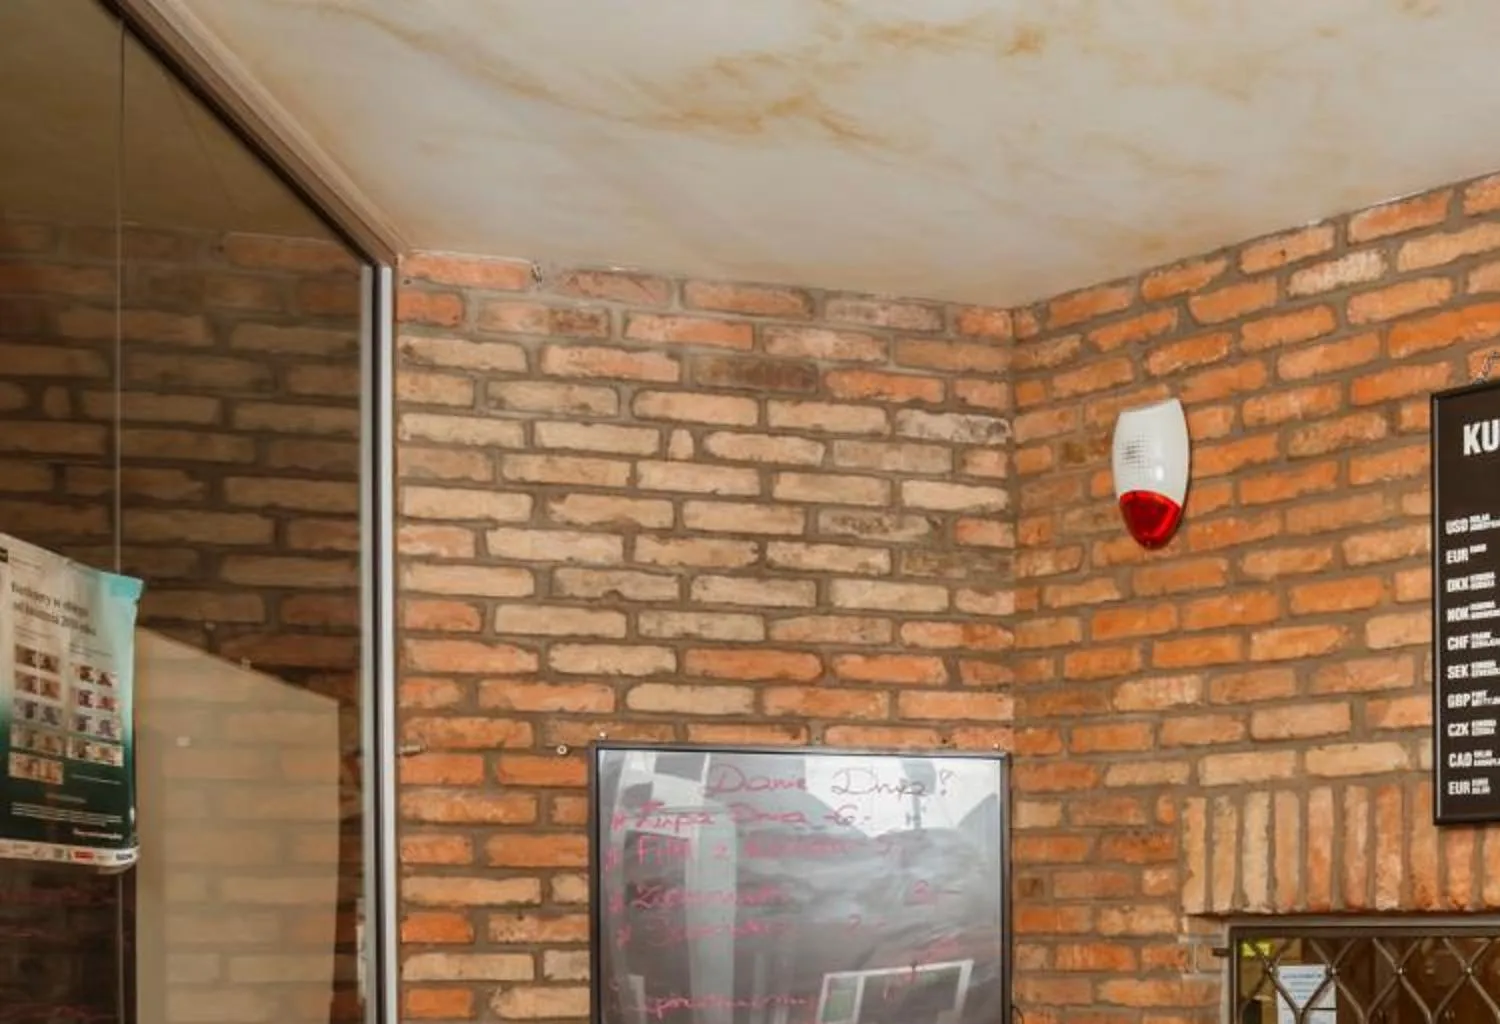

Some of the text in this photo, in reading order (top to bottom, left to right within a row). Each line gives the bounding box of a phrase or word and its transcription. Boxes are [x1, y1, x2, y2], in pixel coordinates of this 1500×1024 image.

[1445, 517, 1469, 535] USD
[1446, 547, 1469, 564] EUR
[1447, 635, 1469, 651] CHF
[1447, 663, 1469, 679] SEK
[1447, 693, 1471, 709] GBP
[1447, 721, 1469, 737] CZK
[1448, 751, 1473, 768] CAD
[1447, 779, 1471, 795] EUR
